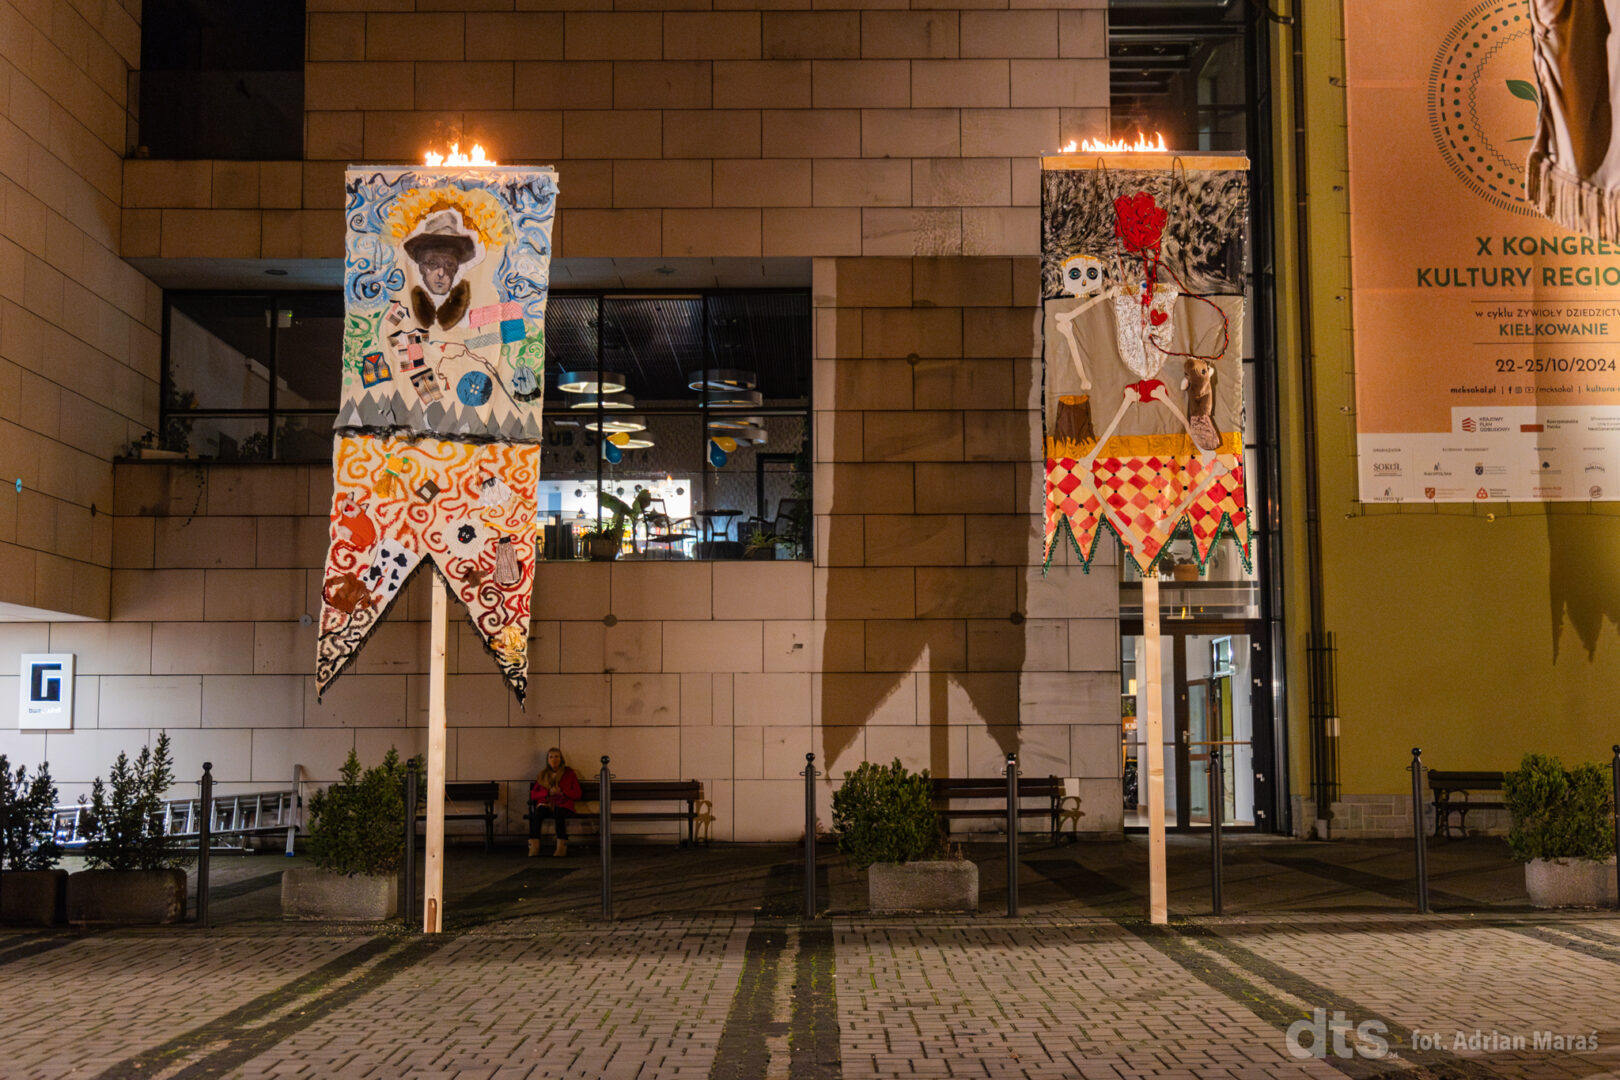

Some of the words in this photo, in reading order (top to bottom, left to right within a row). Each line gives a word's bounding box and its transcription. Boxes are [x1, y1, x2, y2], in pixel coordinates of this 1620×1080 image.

[1476, 236, 1493, 256] X
[1417, 267, 1532, 287] KULTURY
[1487, 307, 1513, 320] cyklu
[1499, 323, 1609, 336] KIEŁKOWANIE
[1495, 357, 1616, 372] 22-25/10/2024
